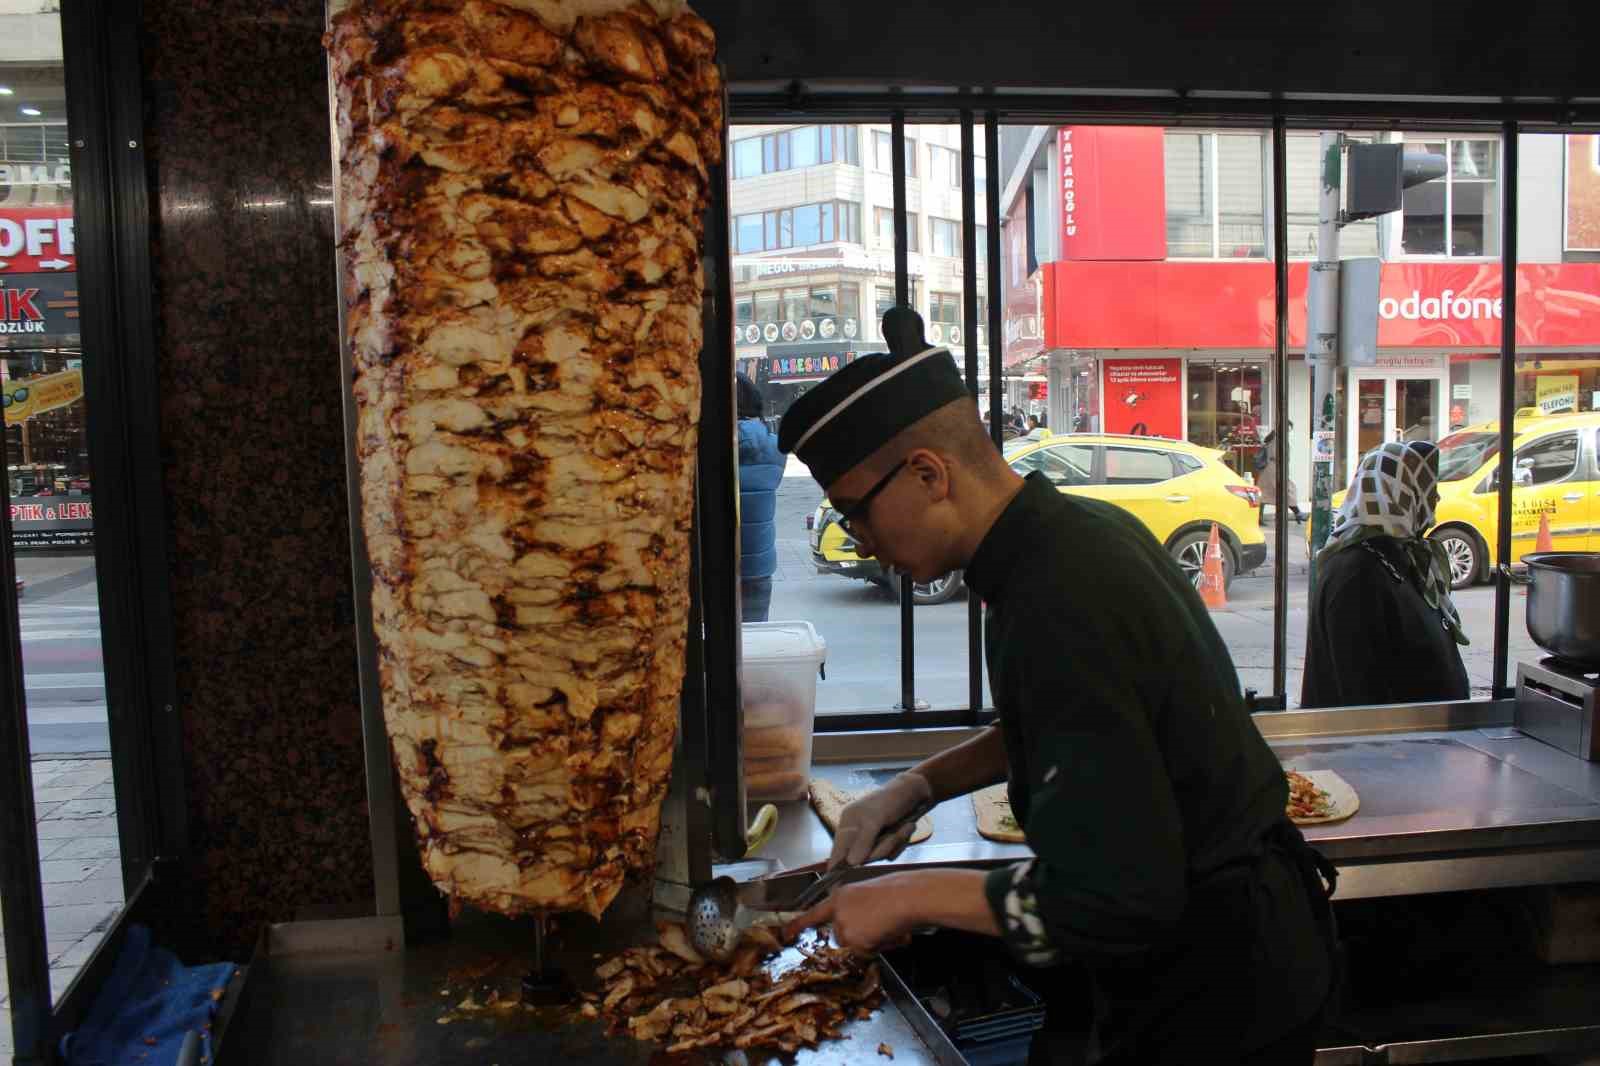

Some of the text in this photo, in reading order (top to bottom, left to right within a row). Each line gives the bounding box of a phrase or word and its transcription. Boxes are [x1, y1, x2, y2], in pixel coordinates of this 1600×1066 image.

[1378, 289, 1503, 320] odafone
[0, 319, 46, 334] OZLÜK
[9, 503, 44, 521] PTİK
